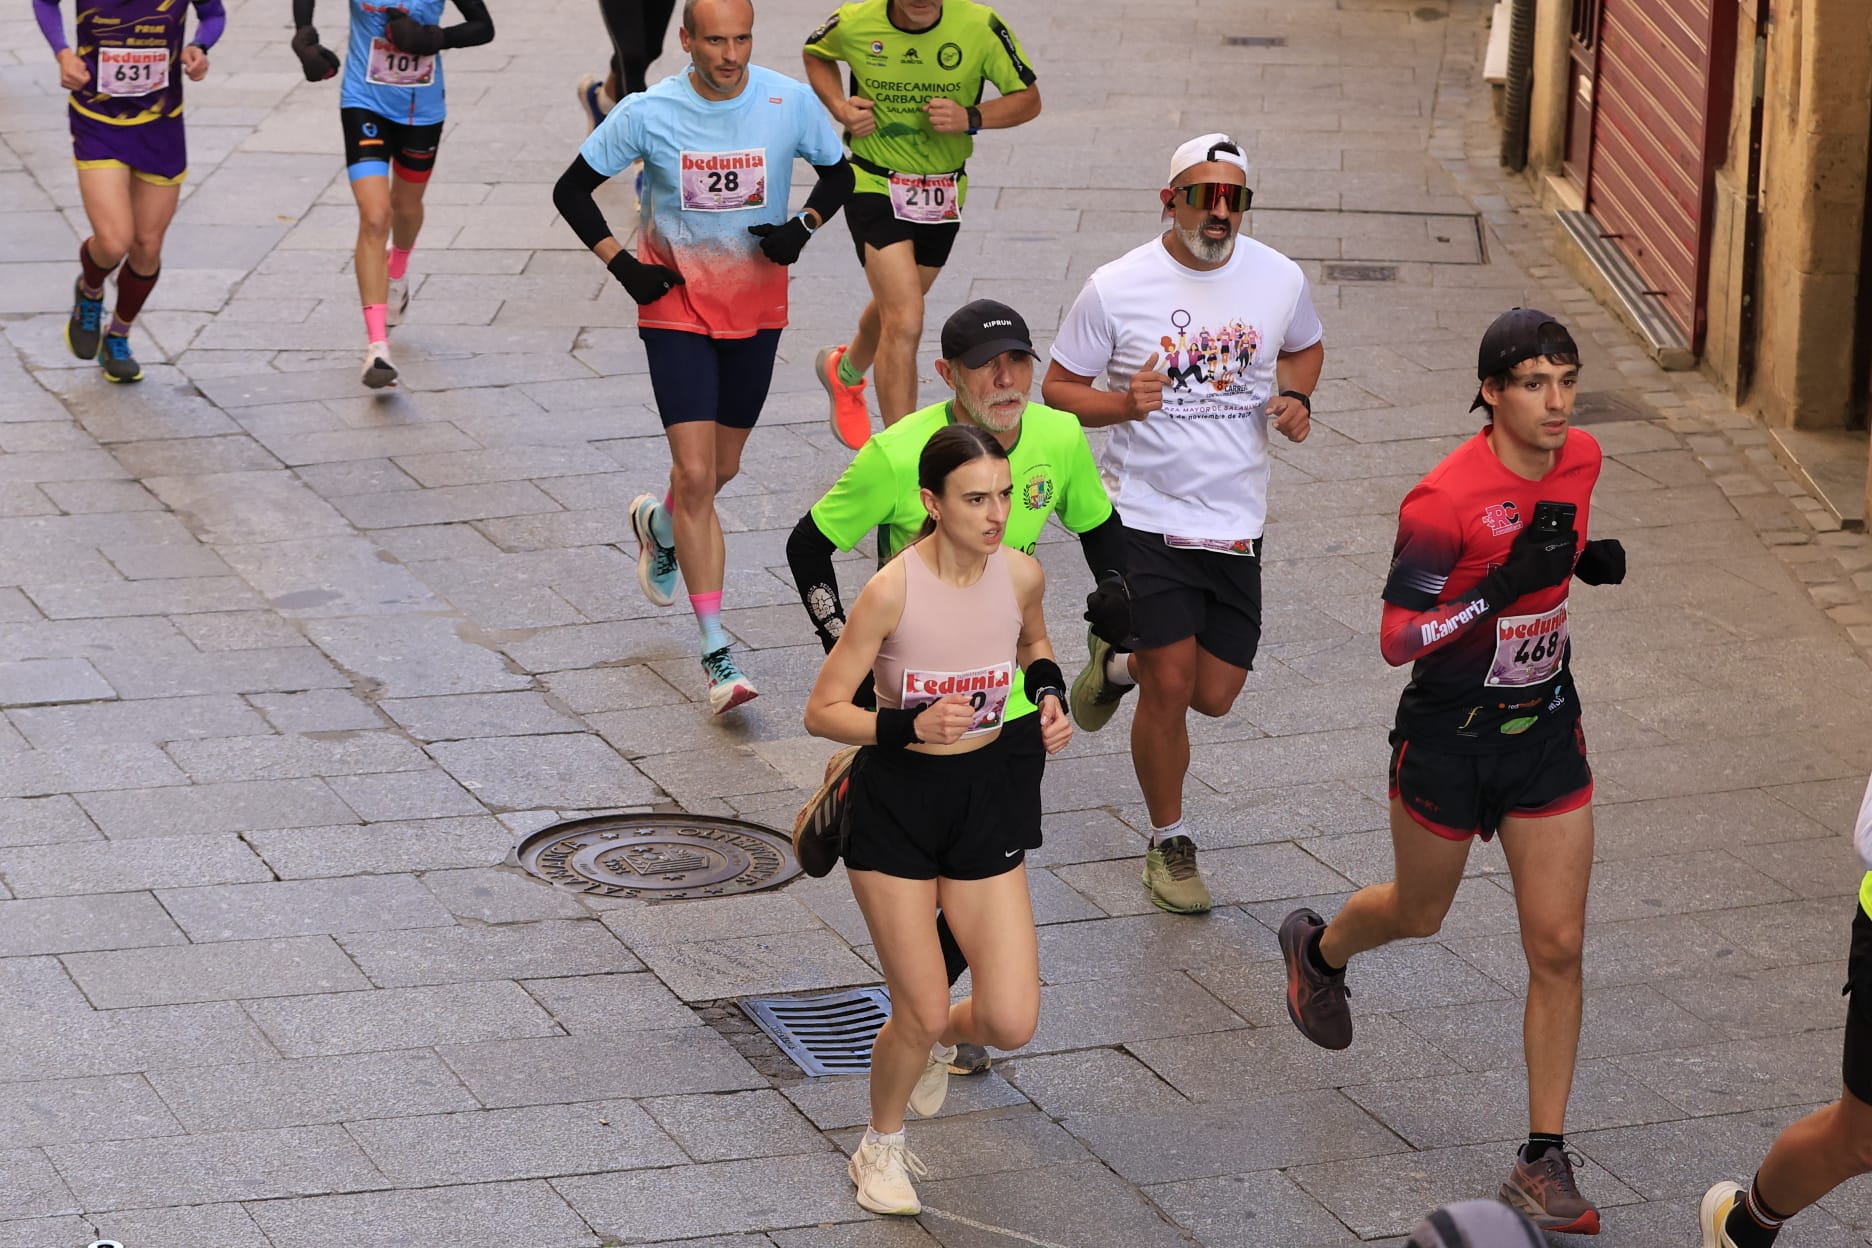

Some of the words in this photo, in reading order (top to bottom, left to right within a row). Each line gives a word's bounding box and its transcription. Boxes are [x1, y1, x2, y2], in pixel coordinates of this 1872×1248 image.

[387, 53, 420, 72] 101
[115, 64, 152, 82] 631
[865, 78, 961, 92] CORRECAMINOS
[876, 92, 949, 104] CARBAJO
[886, 106, 923, 114] SALAMA
[682, 152, 764, 170] bedunia
[707, 170, 739, 193] 28
[905, 186, 945, 207] 210
[982, 319, 1013, 330] KIPRUN
[1188, 413, 1226, 421] noviembre
[1227, 412, 1236, 420] de
[1514, 631, 1560, 665] 468
[541, 841, 642, 899] SALAMANCA
